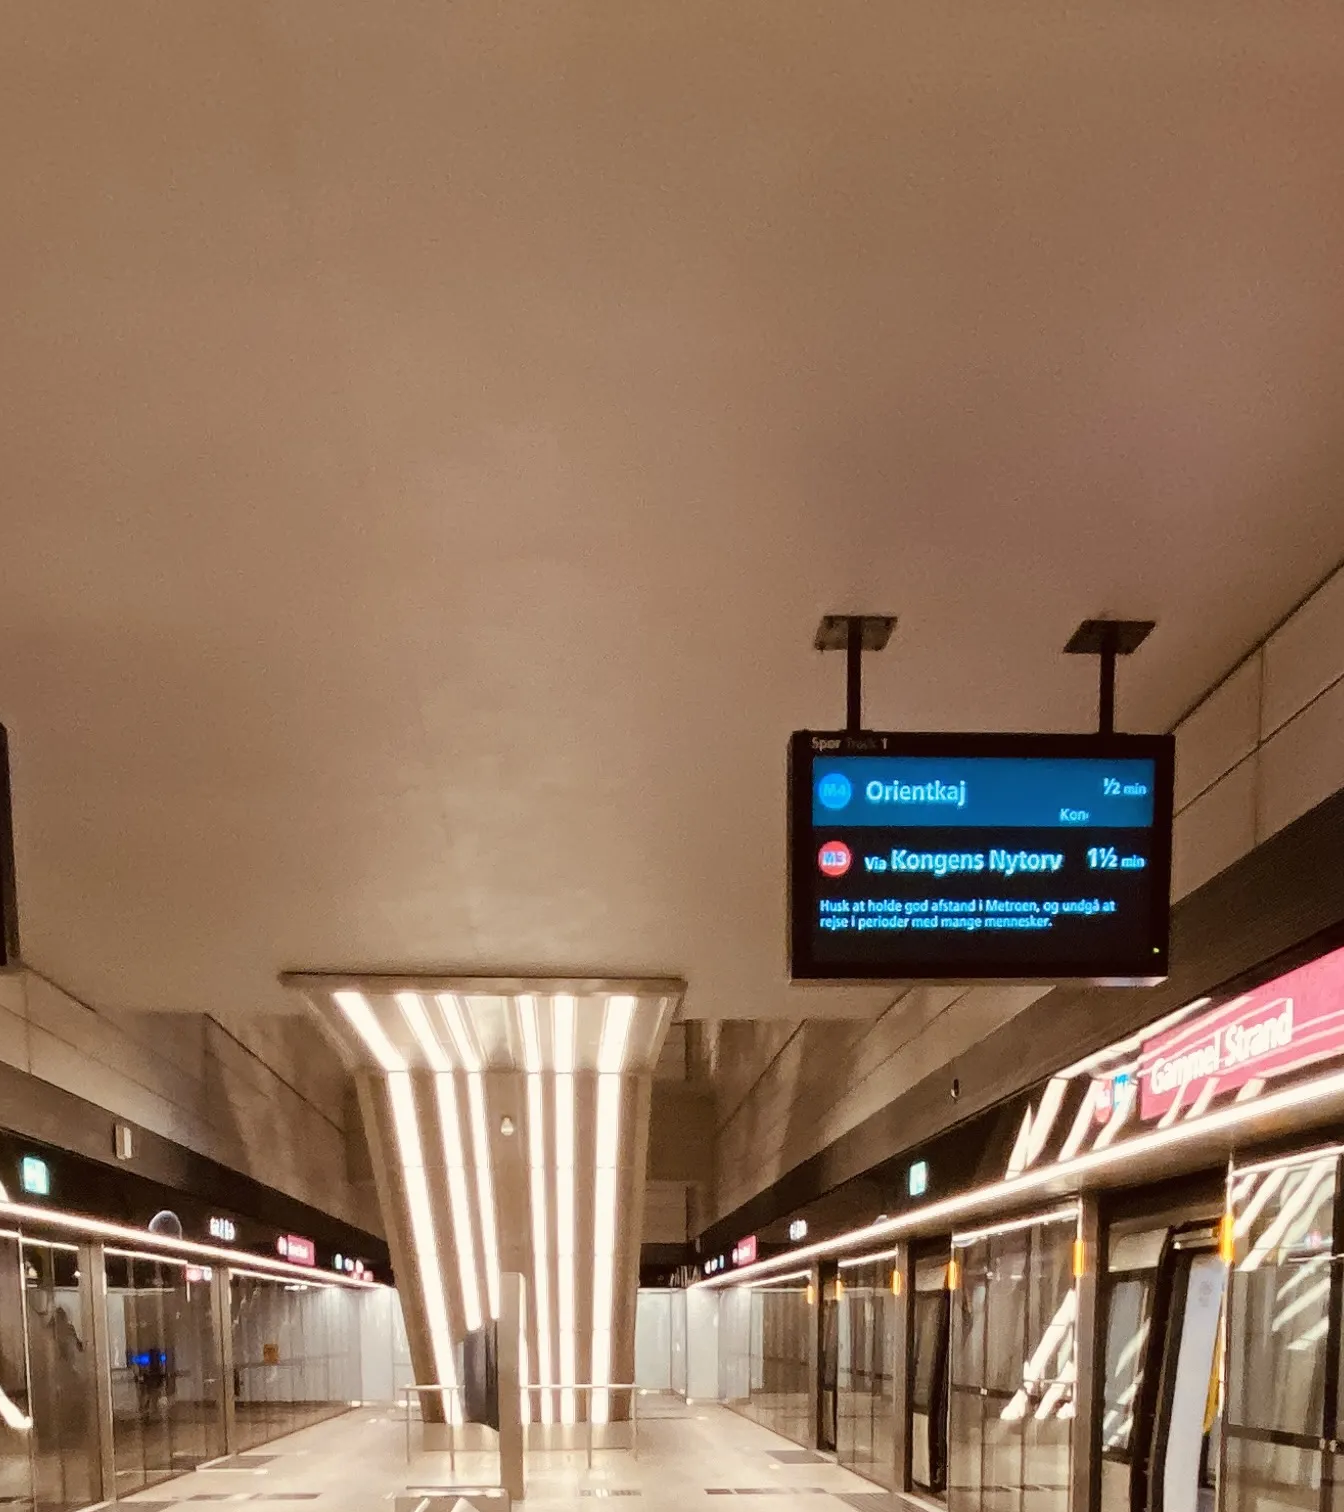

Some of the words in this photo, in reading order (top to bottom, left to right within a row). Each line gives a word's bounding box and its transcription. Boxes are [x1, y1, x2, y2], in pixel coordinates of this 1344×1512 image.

[812, 737, 841, 751] Spor
[881, 737, 888, 749] 1
[866, 780, 966, 806] Orientkaj
[1124, 783, 1146, 795] min
[822, 852, 846, 866] M3
[865, 857, 887, 870] Via
[891, 849, 984, 875] Kongens
[989, 849, 1063, 875] Nytorv
[1121, 855, 1145, 868] min
[819, 900, 850, 912] Husk
[852, 901, 865, 912] at
[867, 900, 902, 912] holde
[905, 899, 928, 914] god
[931, 899, 975, 912] afstand
[985, 899, 1040, 913] Metroen,
[1043, 902, 1058, 914] og
[1062, 899, 1100, 914] undgå
[1102, 900, 1116, 912] at
[819, 915, 848, 930] rejse
[858, 915, 909, 930] perioder
[911, 915, 938, 928] med
[941, 917, 982, 930] mange
[984, 915, 1053, 928] mennesker.
[1225, 998, 1293, 1066] Strand
